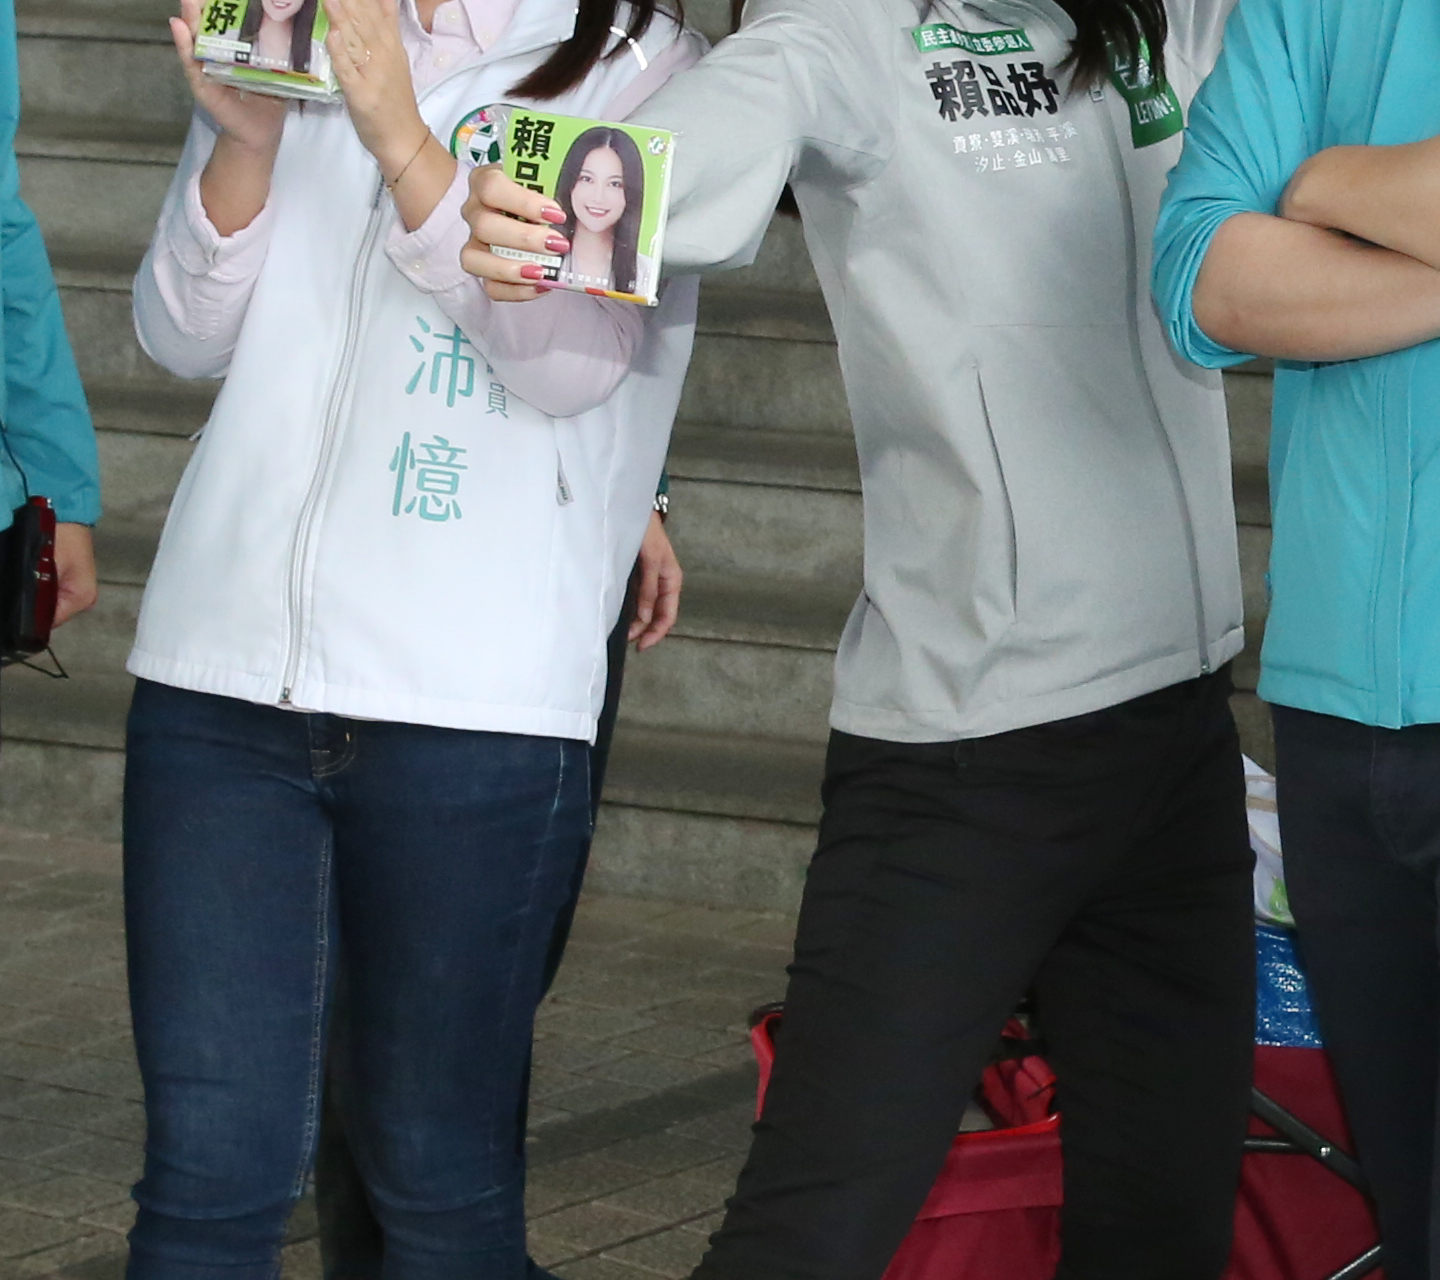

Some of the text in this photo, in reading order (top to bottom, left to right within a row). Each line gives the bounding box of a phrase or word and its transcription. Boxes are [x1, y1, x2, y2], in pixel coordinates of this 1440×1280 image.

[925, 60, 1060, 122] 賴品妤
[503, 116, 556, 224] 賴品
[389, 315, 475, 522] 沛憶
